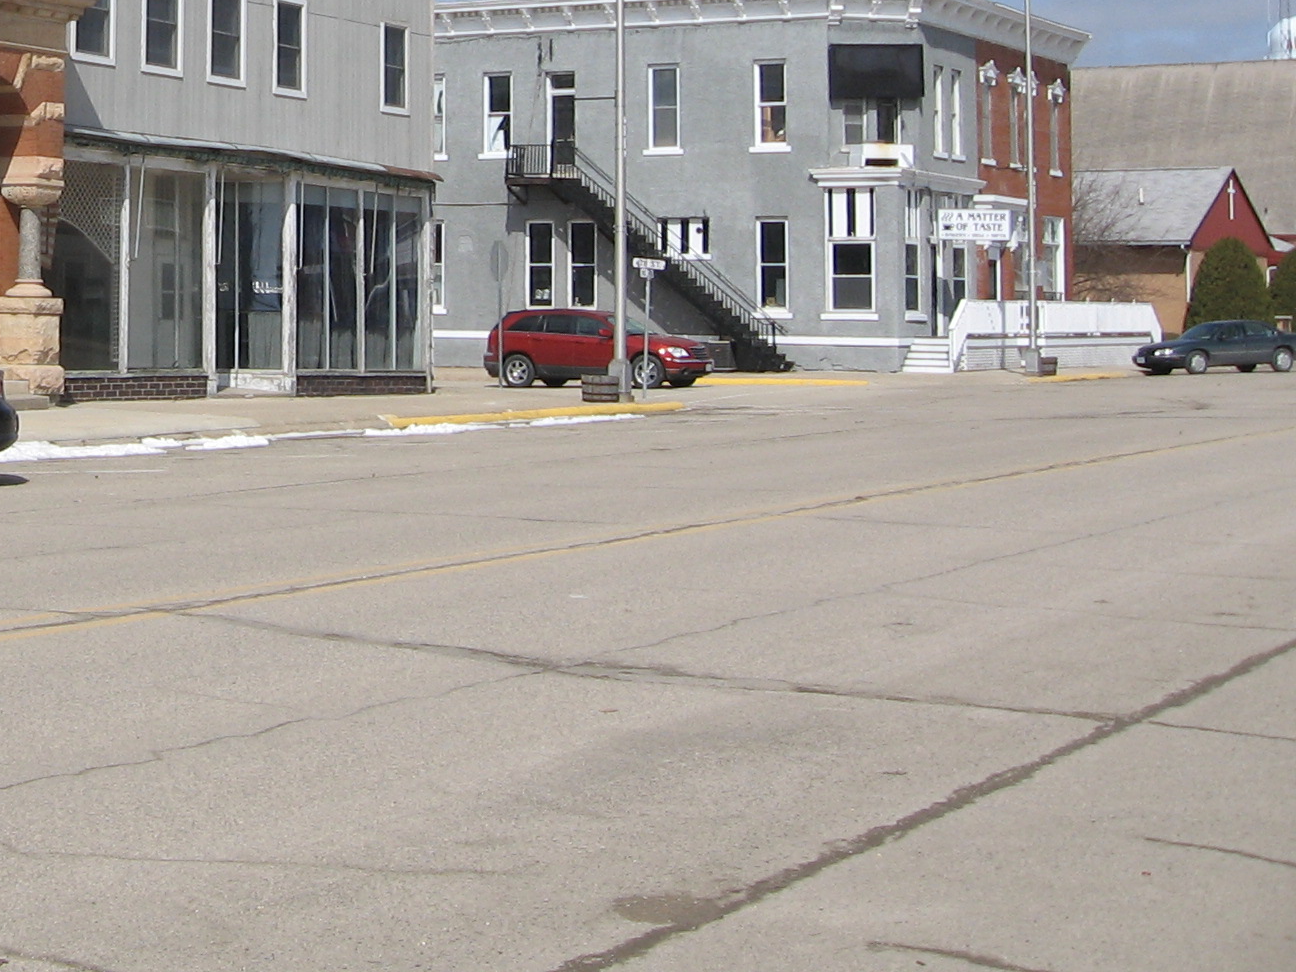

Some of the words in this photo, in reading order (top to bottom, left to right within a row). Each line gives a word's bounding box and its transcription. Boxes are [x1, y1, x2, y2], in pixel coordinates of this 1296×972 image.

[956, 212, 964, 221] A
[967, 212, 1007, 222] MATTER
[956, 222, 968, 231] OF
[974, 223, 1003, 232] TASTE
